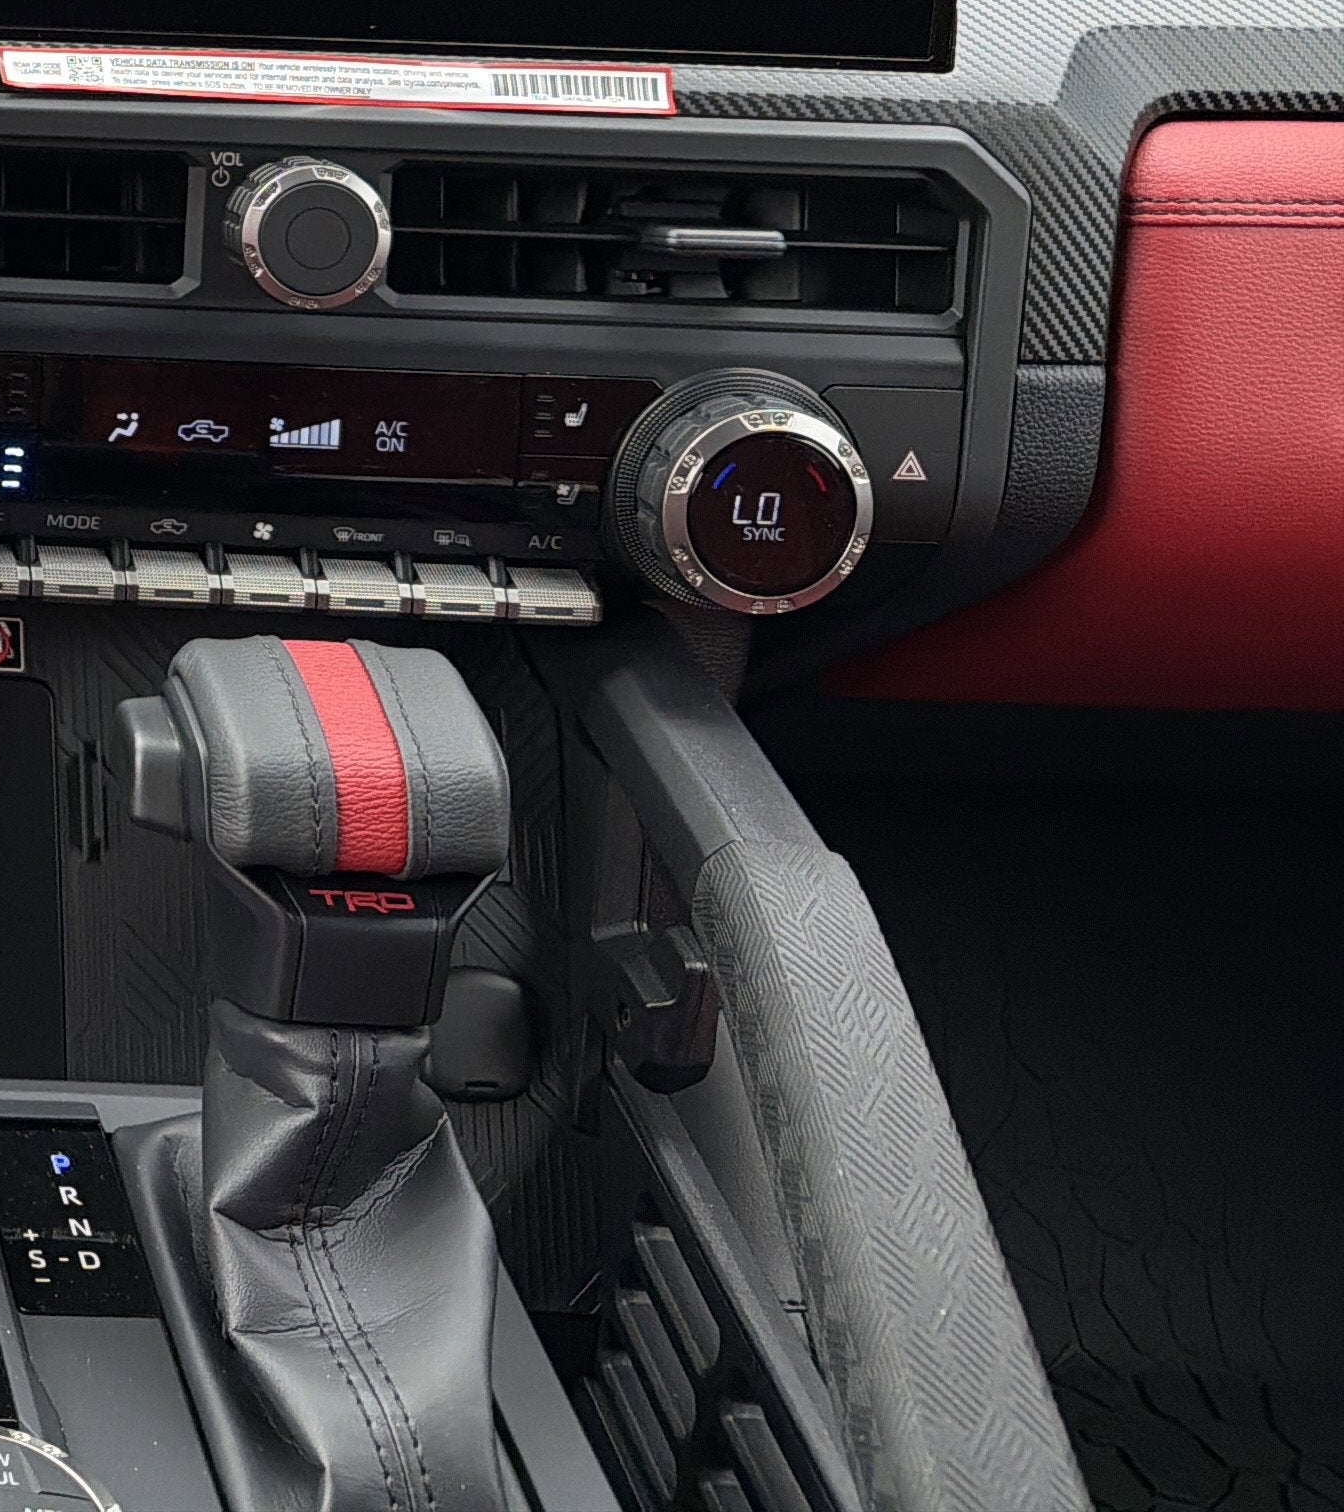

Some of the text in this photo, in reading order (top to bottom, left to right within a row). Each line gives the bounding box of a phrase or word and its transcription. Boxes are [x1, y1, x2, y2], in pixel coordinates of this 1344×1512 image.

[110, 57, 144, 66] VEHICLE
[146, 58, 167, 67] DATA
[168, 59, 229, 69] TRANSMISSION
[211, 151, 244, 167] VOL
[374, 420, 410, 437] A/C
[375, 437, 405, 453] ON
[46, 513, 102, 531] MODE
[353, 532, 385, 542] FRONT
[527, 534, 563, 551] A/C
[742, 526, 786, 543] SYNC
[308, 888, 416, 915] TRD
[50, 1154, 72, 1175] P
[58, 1185, 84, 1206] R
[68, 1218, 93, 1237] N
[28, 1249, 102, 1270] S D
